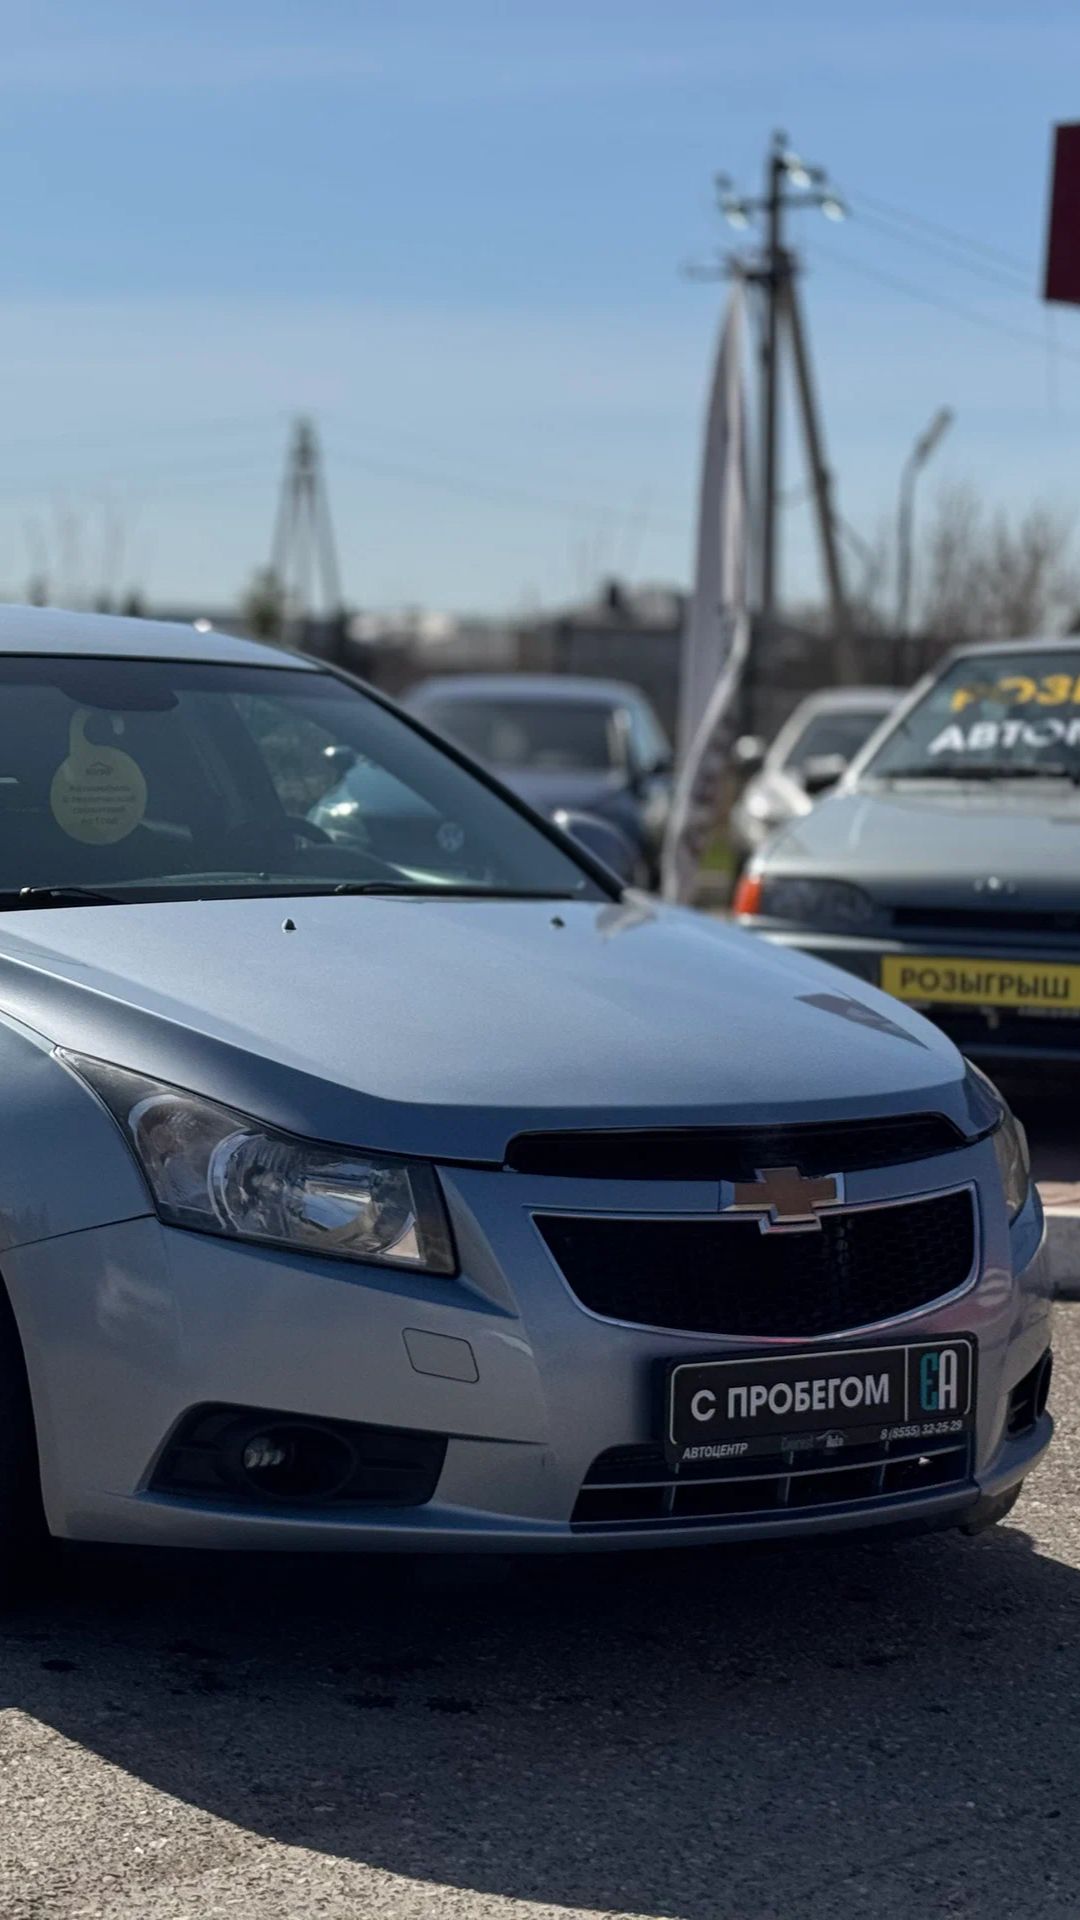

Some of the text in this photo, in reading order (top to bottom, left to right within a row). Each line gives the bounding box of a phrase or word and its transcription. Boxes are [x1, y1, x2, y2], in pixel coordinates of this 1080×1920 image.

[949, 673, 1080, 712] РОЗ
[900, 967, 1069, 999] РОЗЫГРЫШ
[690, 1373, 889, 1421] С ПРОБЕГОМ
[682, 1442, 748, 1459] АВТОЦЕНТР
